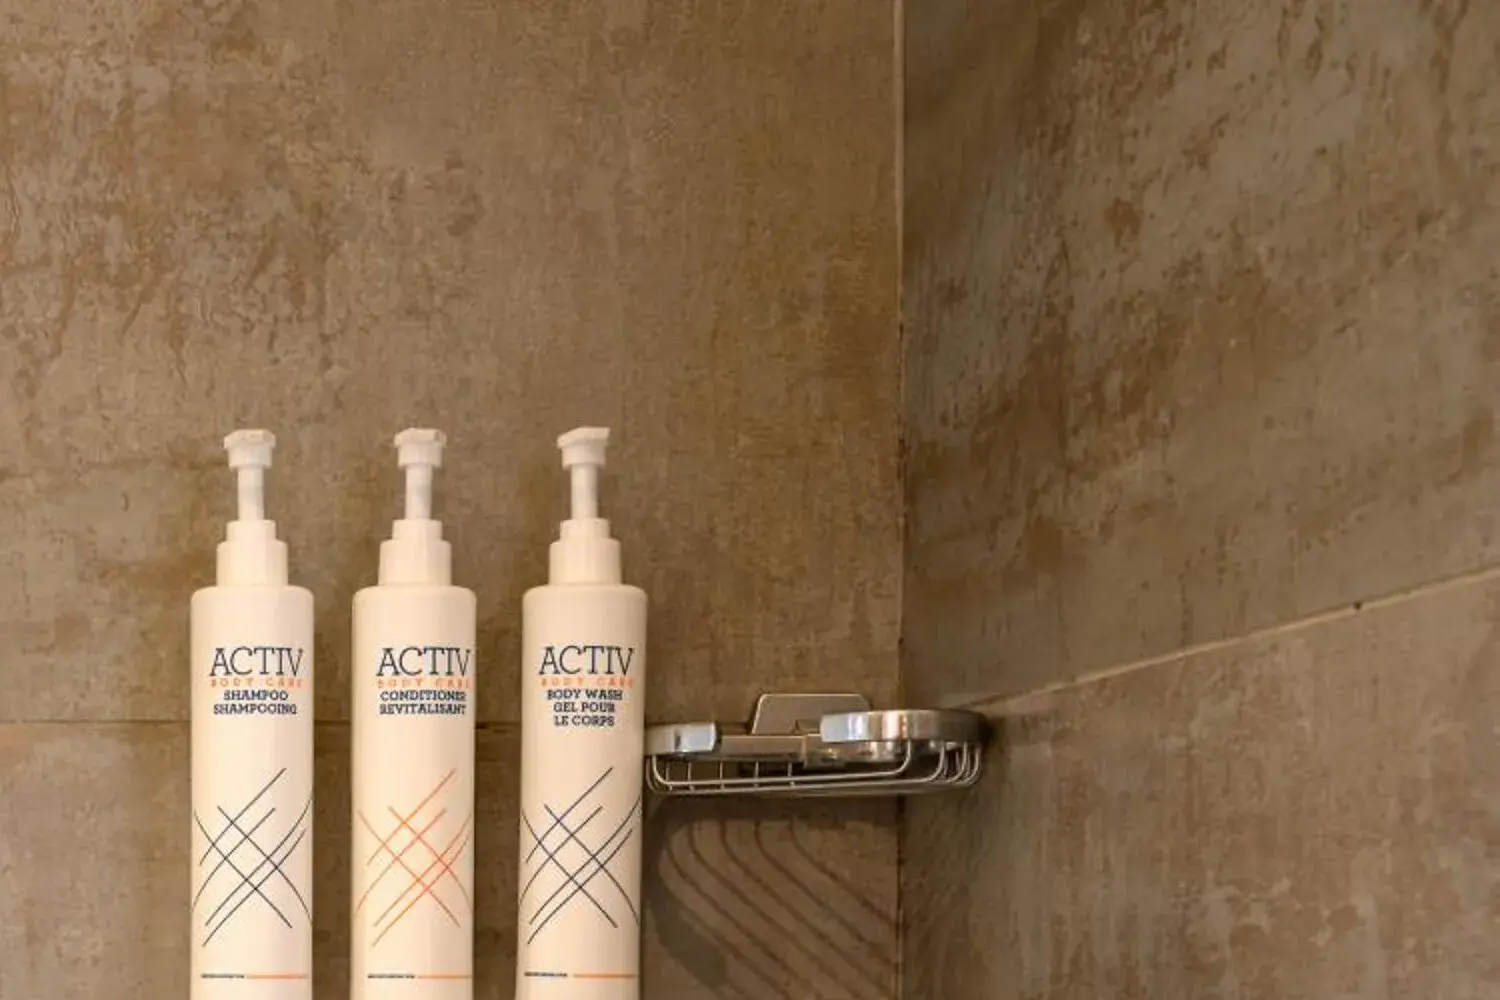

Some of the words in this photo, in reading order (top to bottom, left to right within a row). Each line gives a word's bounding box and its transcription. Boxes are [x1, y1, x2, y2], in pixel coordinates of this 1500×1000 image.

[209, 646, 303, 677] ACTIV
[376, 646, 471, 677] ACTIV
[539, 645, 634, 676] ACTIV
[223, 689, 289, 701] SHAMPOO
[379, 690, 467, 701] CONDITIONER
[547, 689, 581, 700] BODY
[585, 689, 623, 700] WASH
[213, 703, 298, 715] SHAMPOOING
[379, 703, 467, 715] REVITALISANT
[553, 702, 578, 713] GEL
[581, 702, 615, 713] POUR
[553, 715, 569, 726] LE
[571, 715, 615, 727] CORPS
